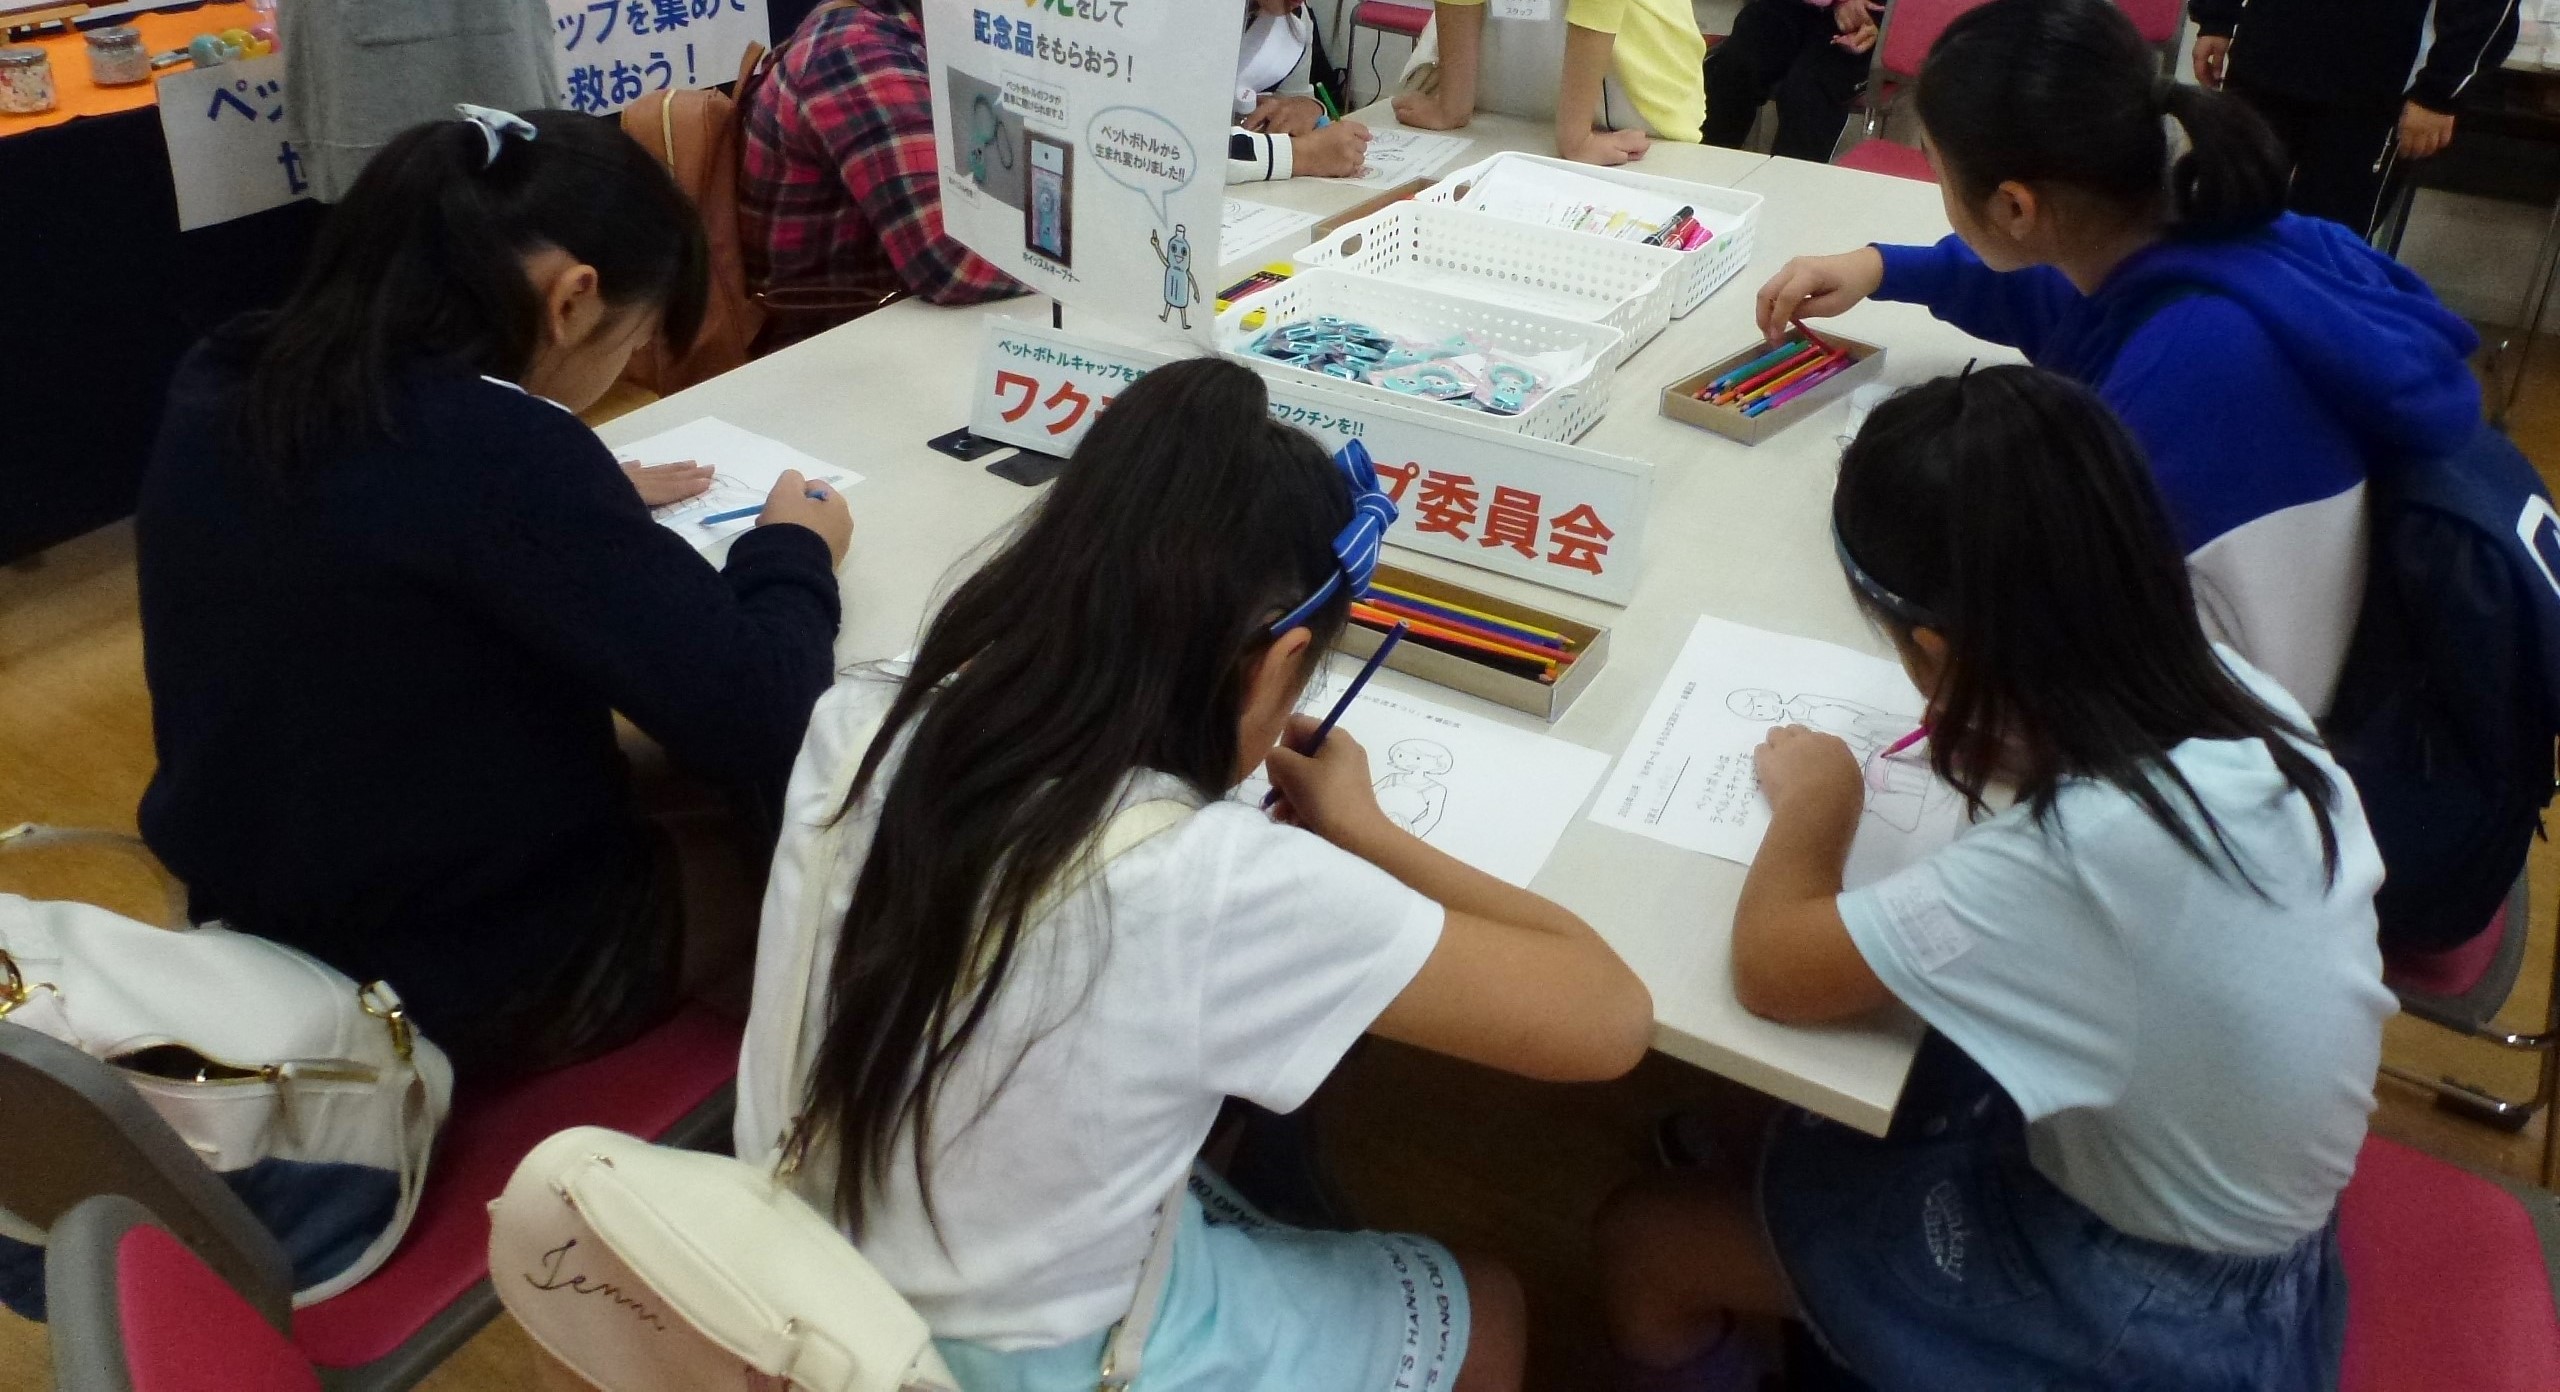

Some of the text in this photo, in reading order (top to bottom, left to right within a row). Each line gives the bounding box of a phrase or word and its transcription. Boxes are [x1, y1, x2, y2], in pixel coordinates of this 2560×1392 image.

[1101, 125, 1181, 161] ペットボトルから
[994, 369, 1616, 577] ワク プ委員会
